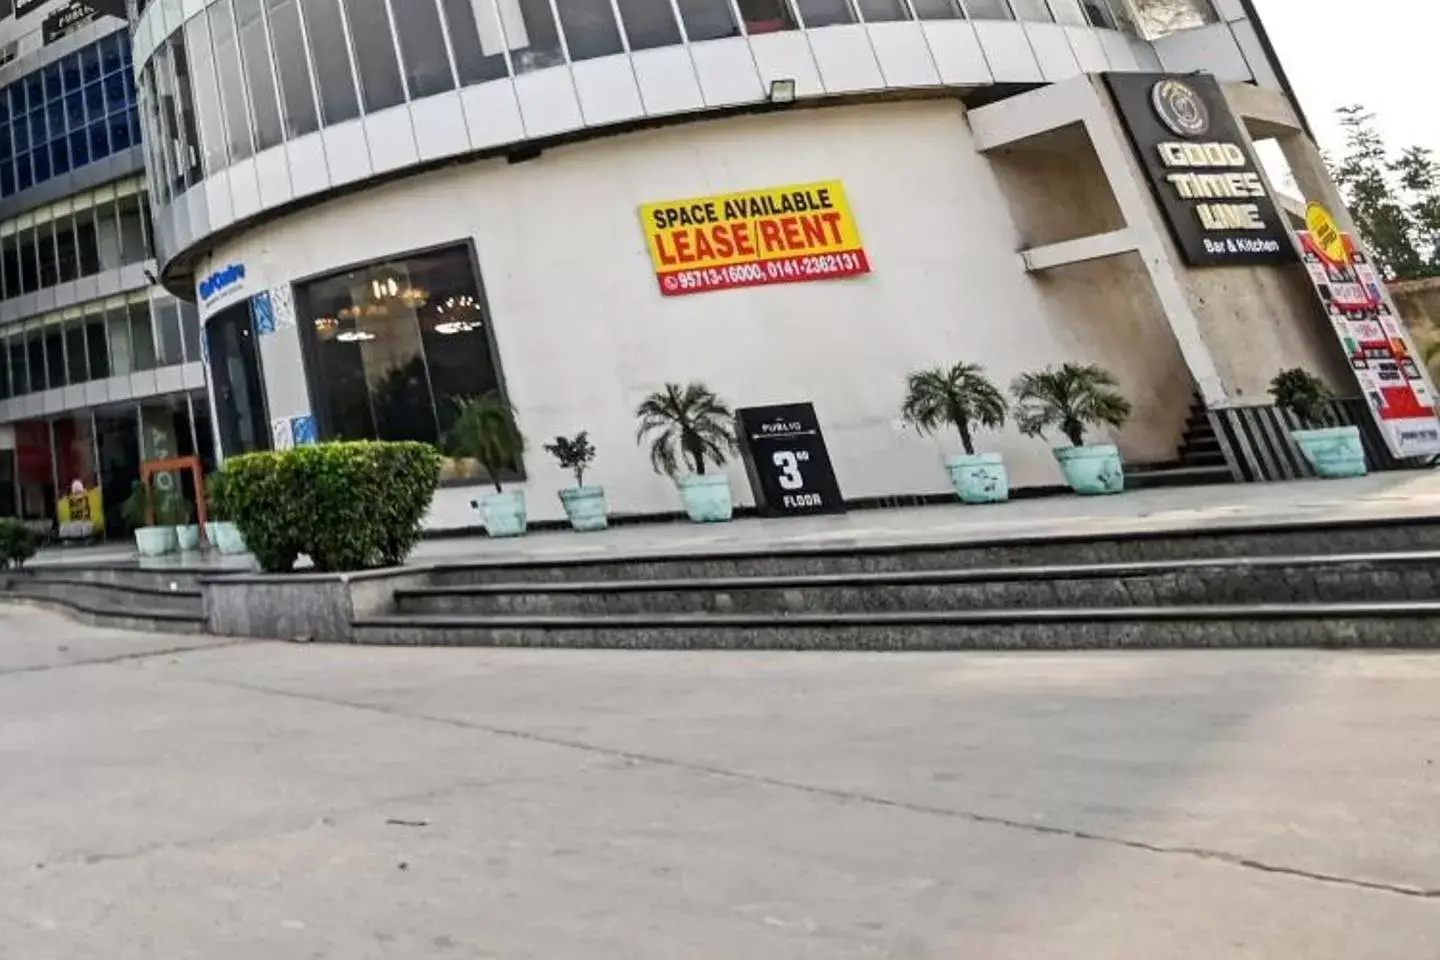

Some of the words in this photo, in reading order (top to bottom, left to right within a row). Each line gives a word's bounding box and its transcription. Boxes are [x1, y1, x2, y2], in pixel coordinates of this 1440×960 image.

[1158, 142, 1246, 167] GOOD
[1166, 172, 1266, 199] TIMES
[653, 203, 718, 229] SPACE
[724, 189, 833, 221] AVAILABLE
[1196, 203, 1266, 230] LIVE
[655, 212, 844, 265] LEASE/RENT
[1203, 238, 1225, 253] Bar
[1226, 238, 1238, 253] &
[1237, 237, 1279, 253] Kitchen
[783, 493, 822, 508] FLOOR
